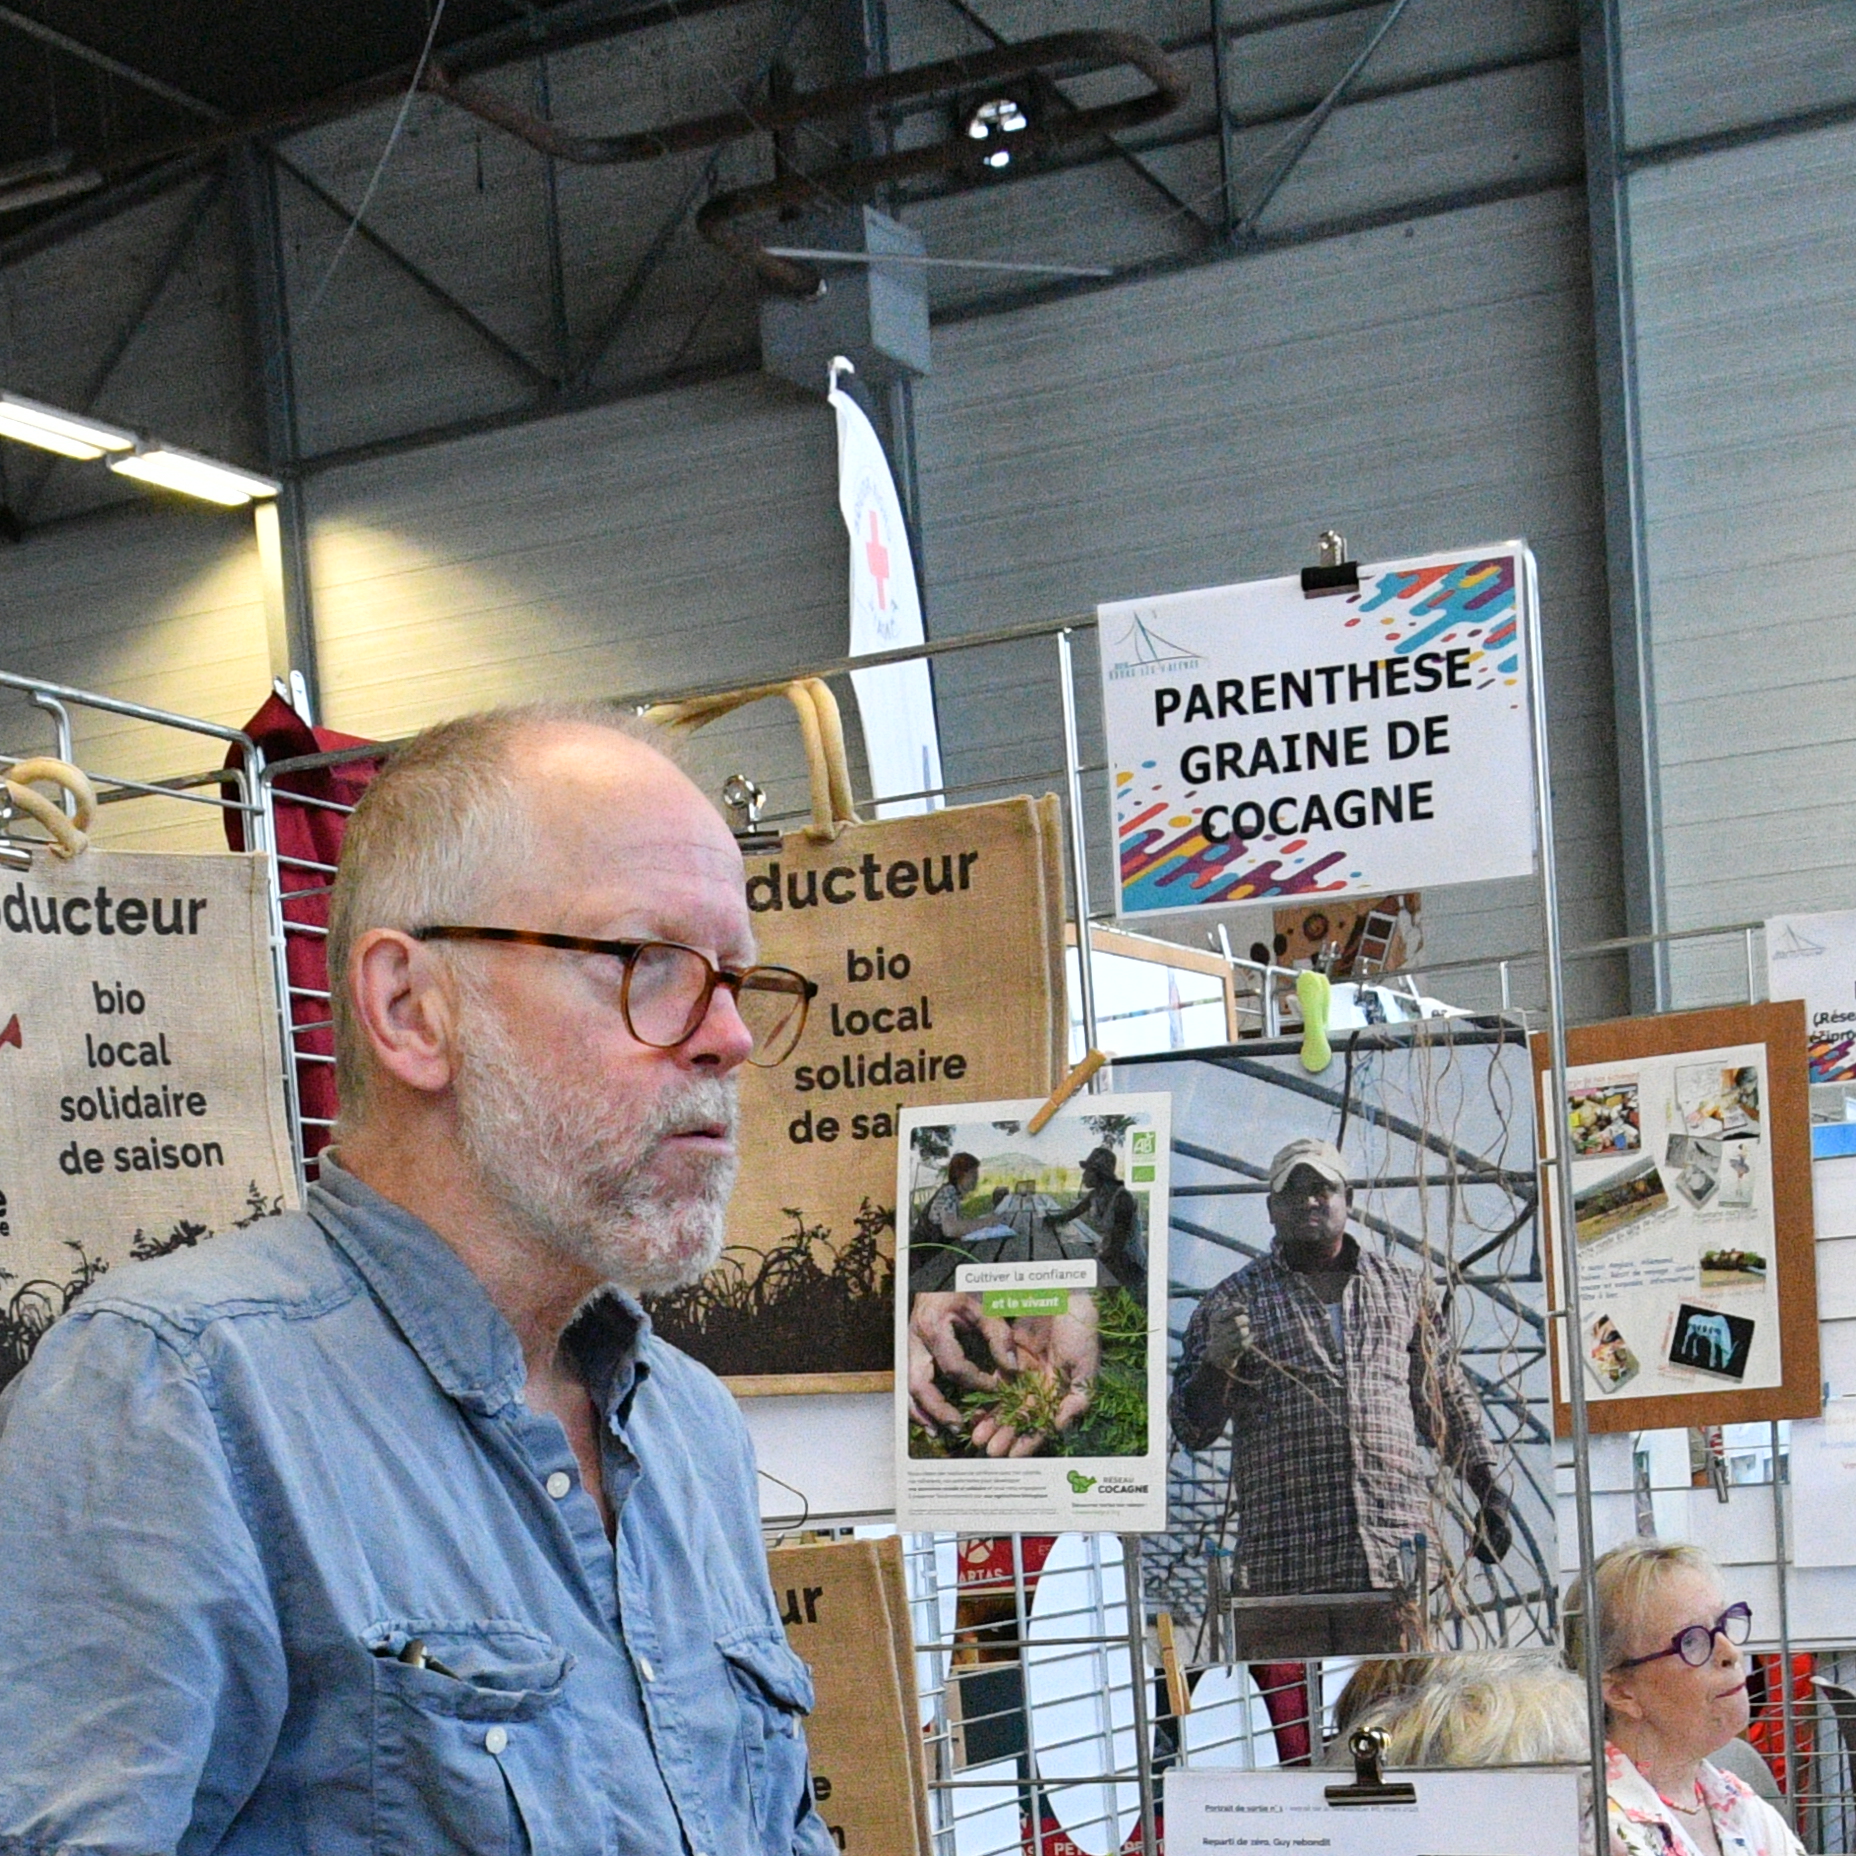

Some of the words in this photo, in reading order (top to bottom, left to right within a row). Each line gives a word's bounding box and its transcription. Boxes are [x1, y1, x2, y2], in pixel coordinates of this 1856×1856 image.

[1154, 647, 1472, 727] PARENTHESE
[1180, 725, 1369, 785] GRAINE
[1388, 715, 1450, 761] DE
[1201, 780, 1434, 845] COCAGNE
[846, 948, 911, 984] bio
[92, 981, 145, 1015] bio
[830, 997, 932, 1039] local
[86, 1033, 171, 1069] local
[794, 1048, 968, 1093] solidaire
[60, 1086, 207, 1122] solidaire
[788, 1110, 840, 1144] de
[59, 1141, 105, 1176] de
[113, 1138, 224, 1174] saison
[965, 1271, 1010, 1283] Cultiver
[1014, 1270, 1025, 1281] la
[1028, 1268, 1087, 1280] confiance
[991, 1299, 1004, 1308] et
[1007, 1298, 1018, 1308] le
[1020, 1296, 1059, 1308] vivant
[1098, 1484, 1149, 1494] COCAGNE
[1203, 1838, 1234, 1847] Reparti
[1237, 1838, 1248, 1846] de
[1274, 1838, 1290, 1847] Guy
